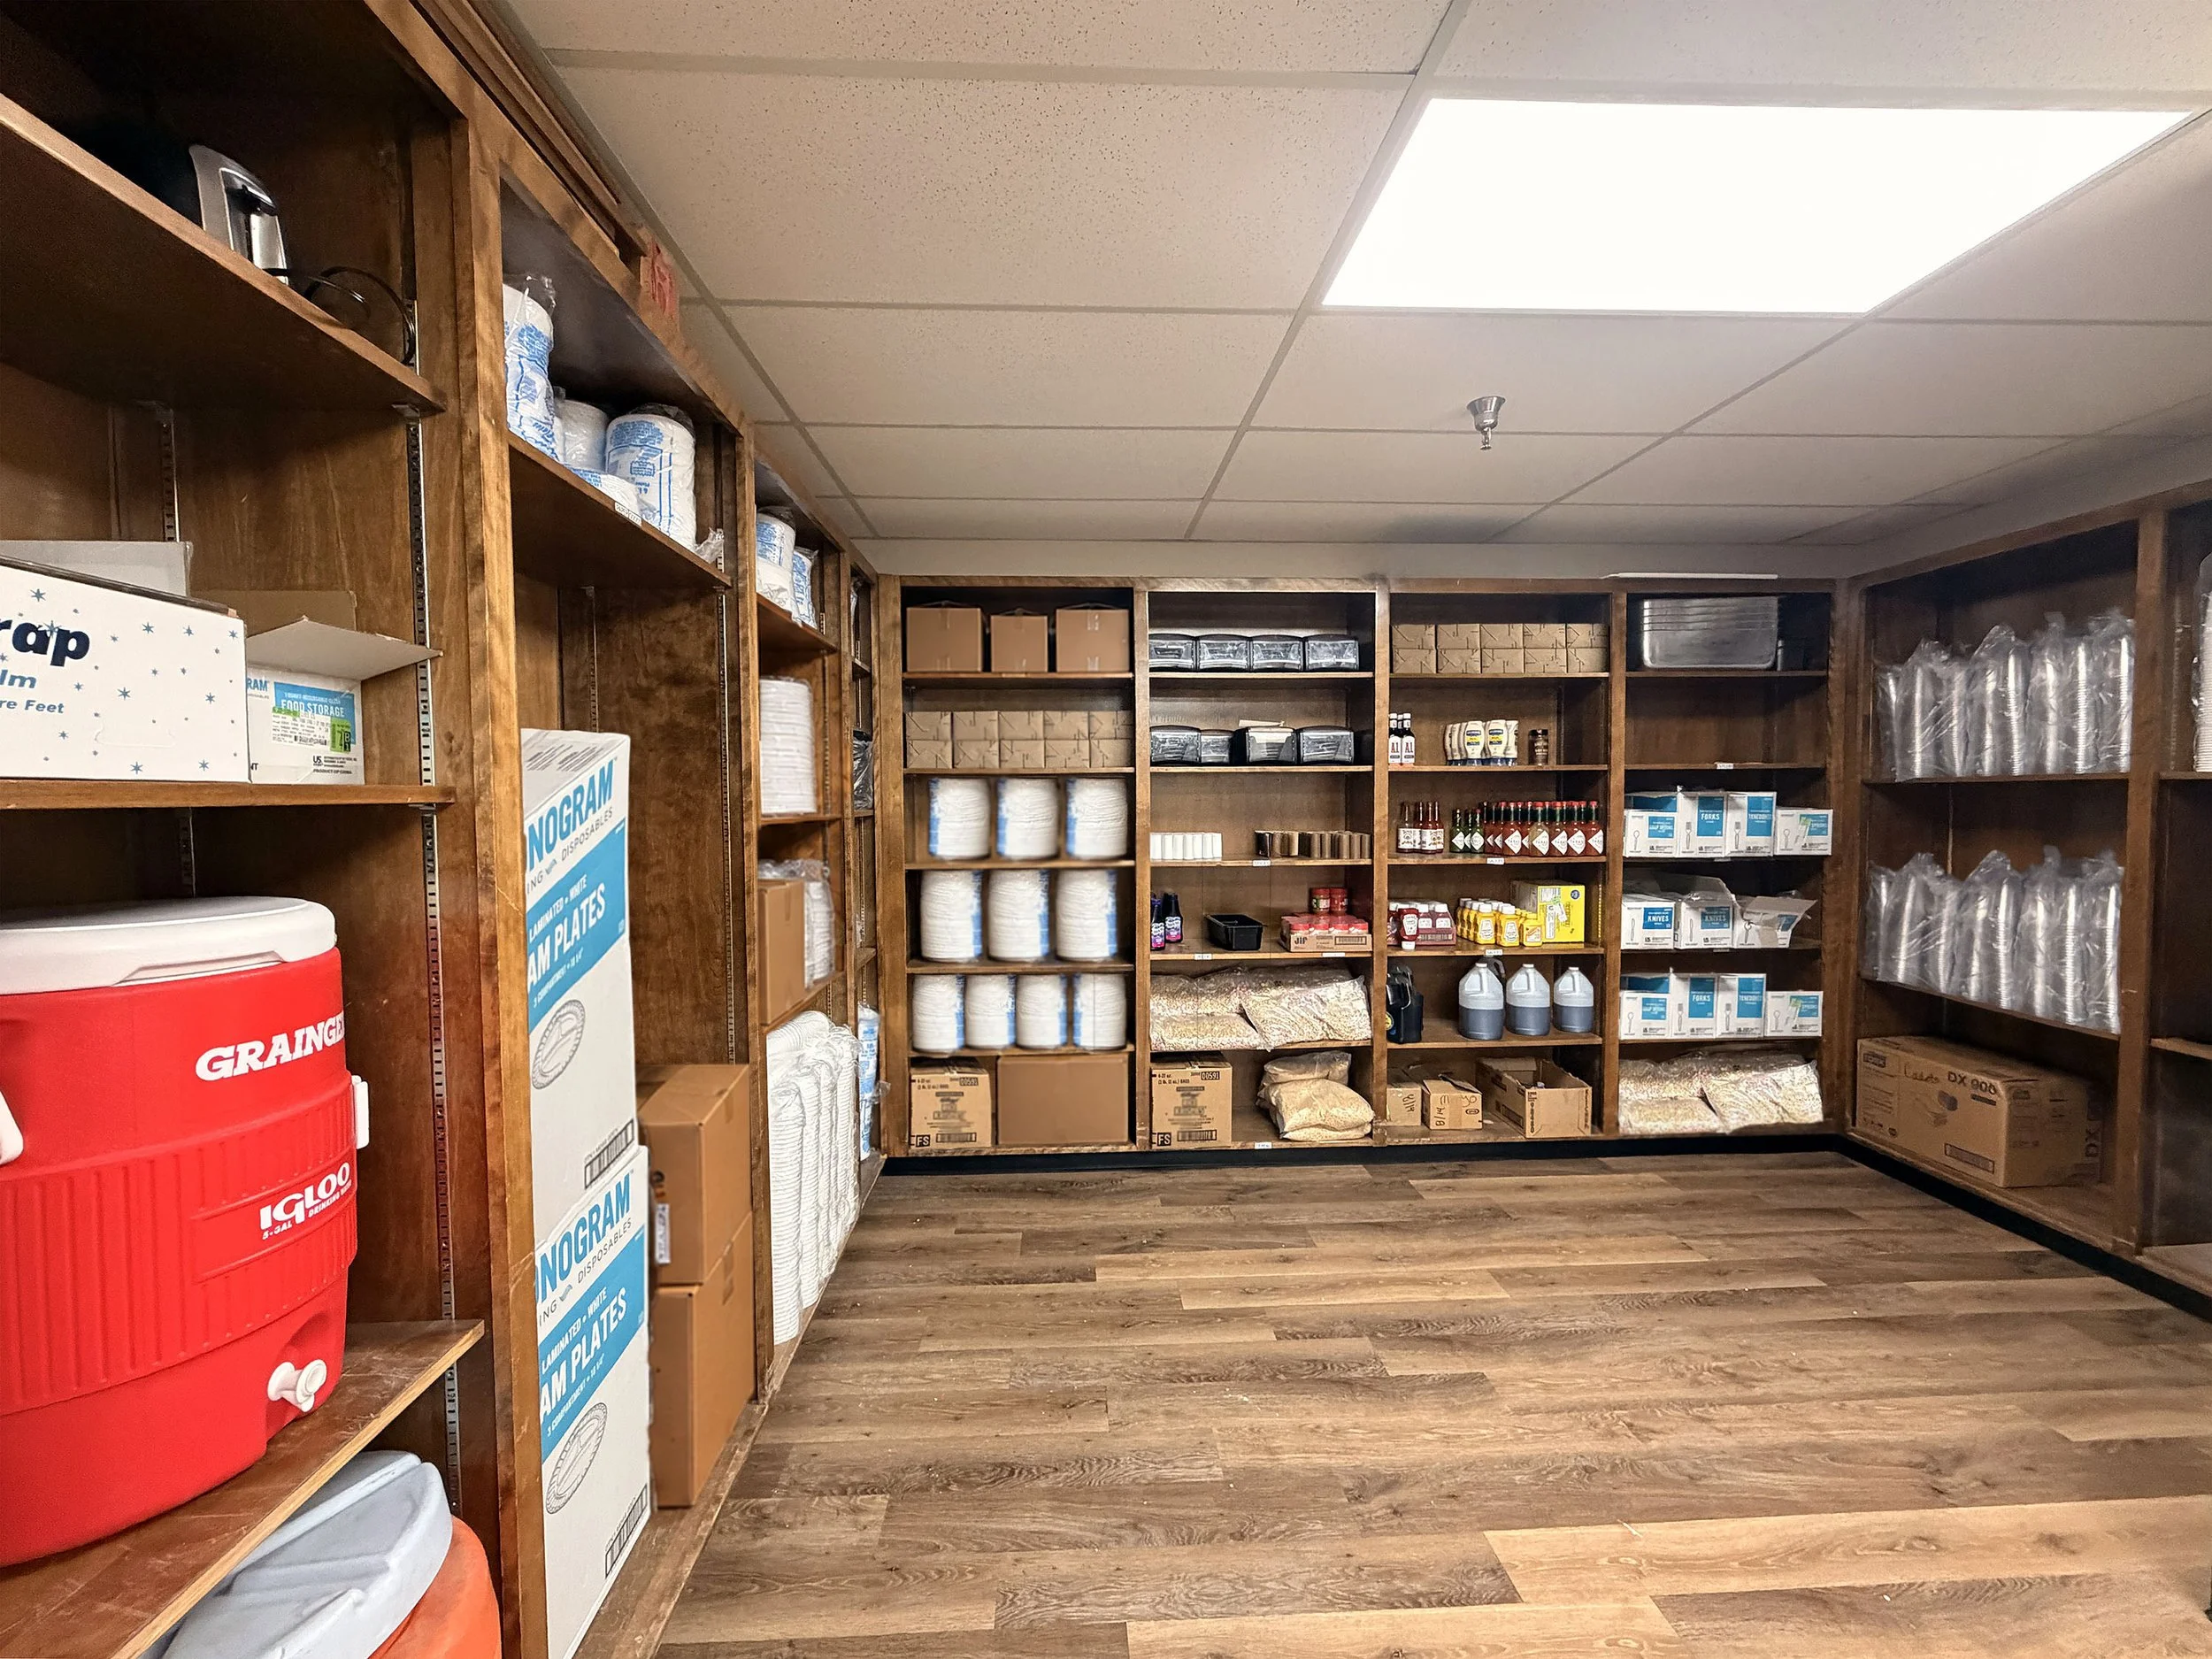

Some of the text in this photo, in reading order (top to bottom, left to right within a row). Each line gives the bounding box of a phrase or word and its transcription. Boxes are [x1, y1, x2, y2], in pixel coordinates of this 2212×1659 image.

[25, 699, 65, 714] Feet
[281, 699, 304, 713] FOOD
[307, 703, 344, 718] STORAGE
[528, 759, 614, 872] NOGRAM
[527, 806, 612, 895] ING DISPOSABLES
[527, 882, 606, 994] AM PLATES
[529, 874, 588, 943] LAMINATED WHITE
[1948, 1071, 1966, 1087] DX
[917, 1136, 929, 1147] FS
[1158, 1133, 1171, 1145] FS
[1433, 1107, 1446, 1126] 8/14
[260, 1162, 349, 1231] IGLOO
[308, 1191, 340, 1218] DRINKING
[539, 1217, 632, 1326] ING DISPOSABLES
[541, 1286, 608, 1375] LAMINATED WHITE
[541, 1287, 627, 1425] AM PLATES
[552, 1378, 585, 1432] COMPARTMENT
